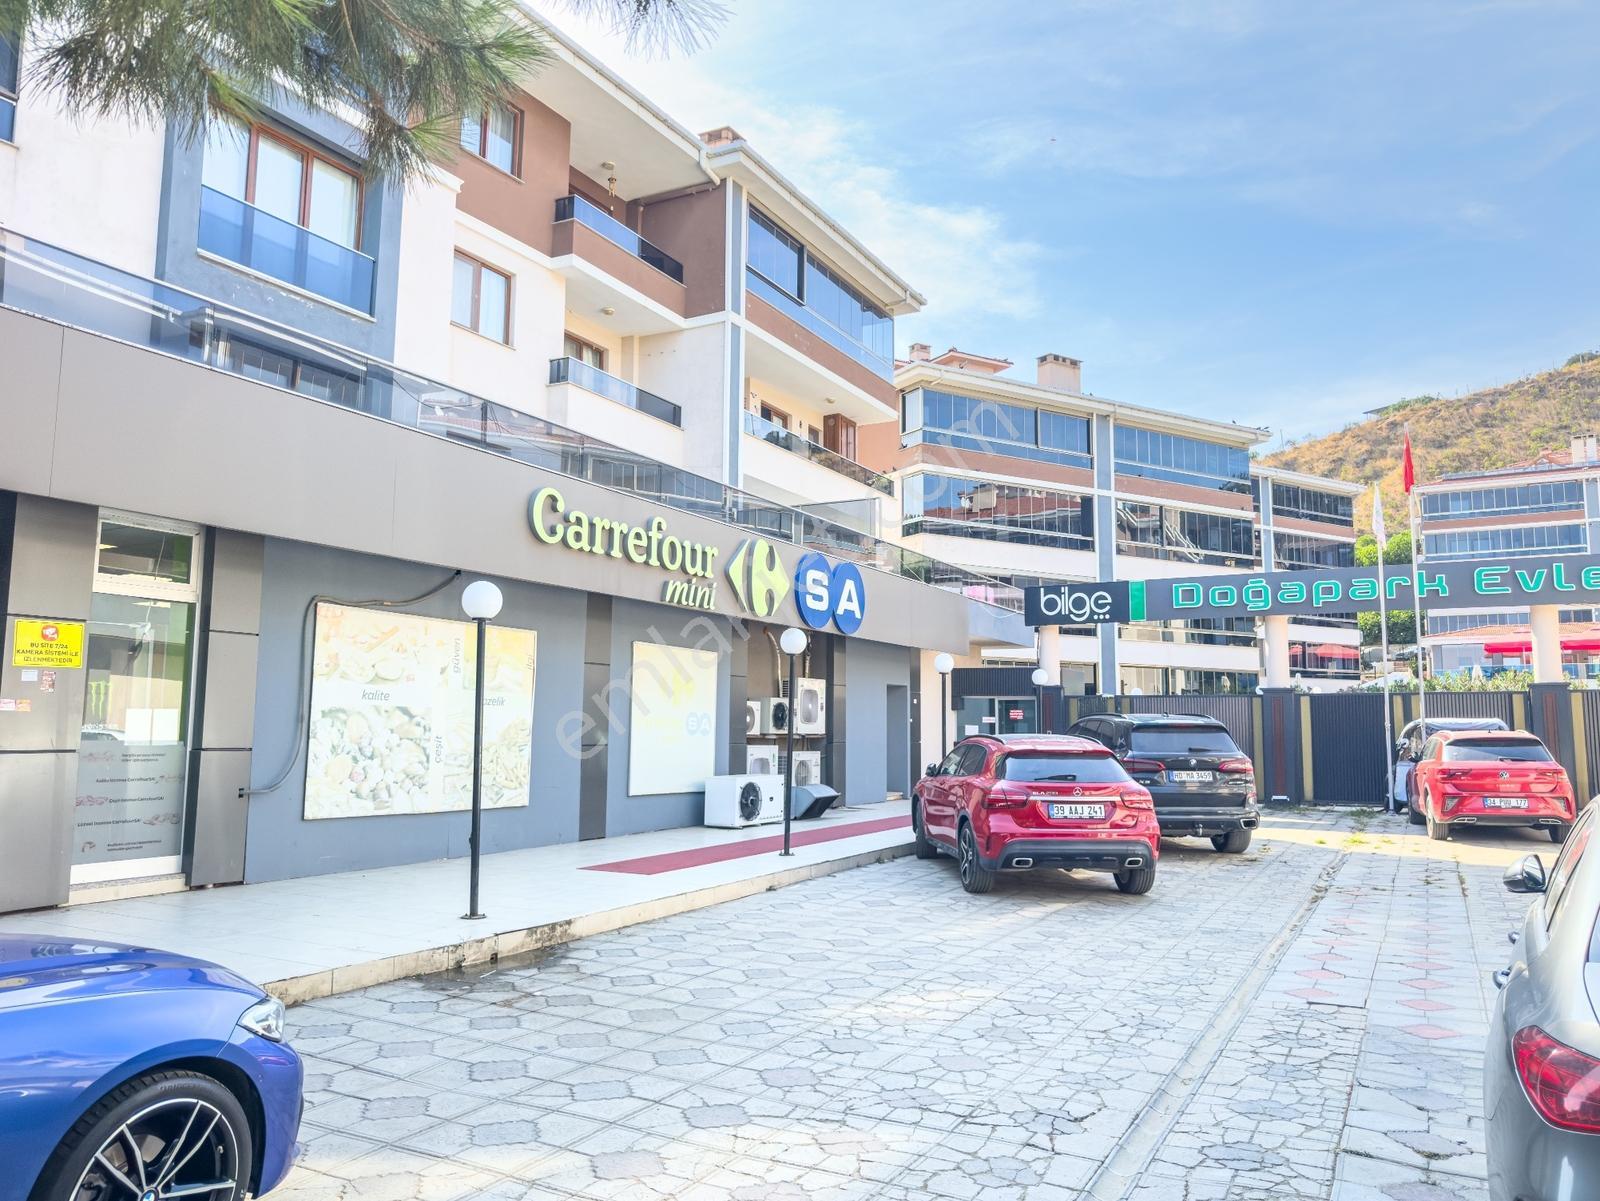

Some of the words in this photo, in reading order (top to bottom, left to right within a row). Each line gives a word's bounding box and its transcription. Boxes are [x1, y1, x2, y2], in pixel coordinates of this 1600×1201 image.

[528, 487, 719, 579] Carrefour
[664, 577, 717, 611] mini
[803, 567, 863, 620] SA
[1040, 586, 1112, 622] bilge
[1172, 569, 1449, 612] Doğapark
[16, 648, 43, 656] KAMERA
[361, 689, 390, 701] kalite
[1055, 805, 1065, 815] 39
[1069, 805, 1084, 815] AAJ
[1088, 805, 1103, 815] 241
